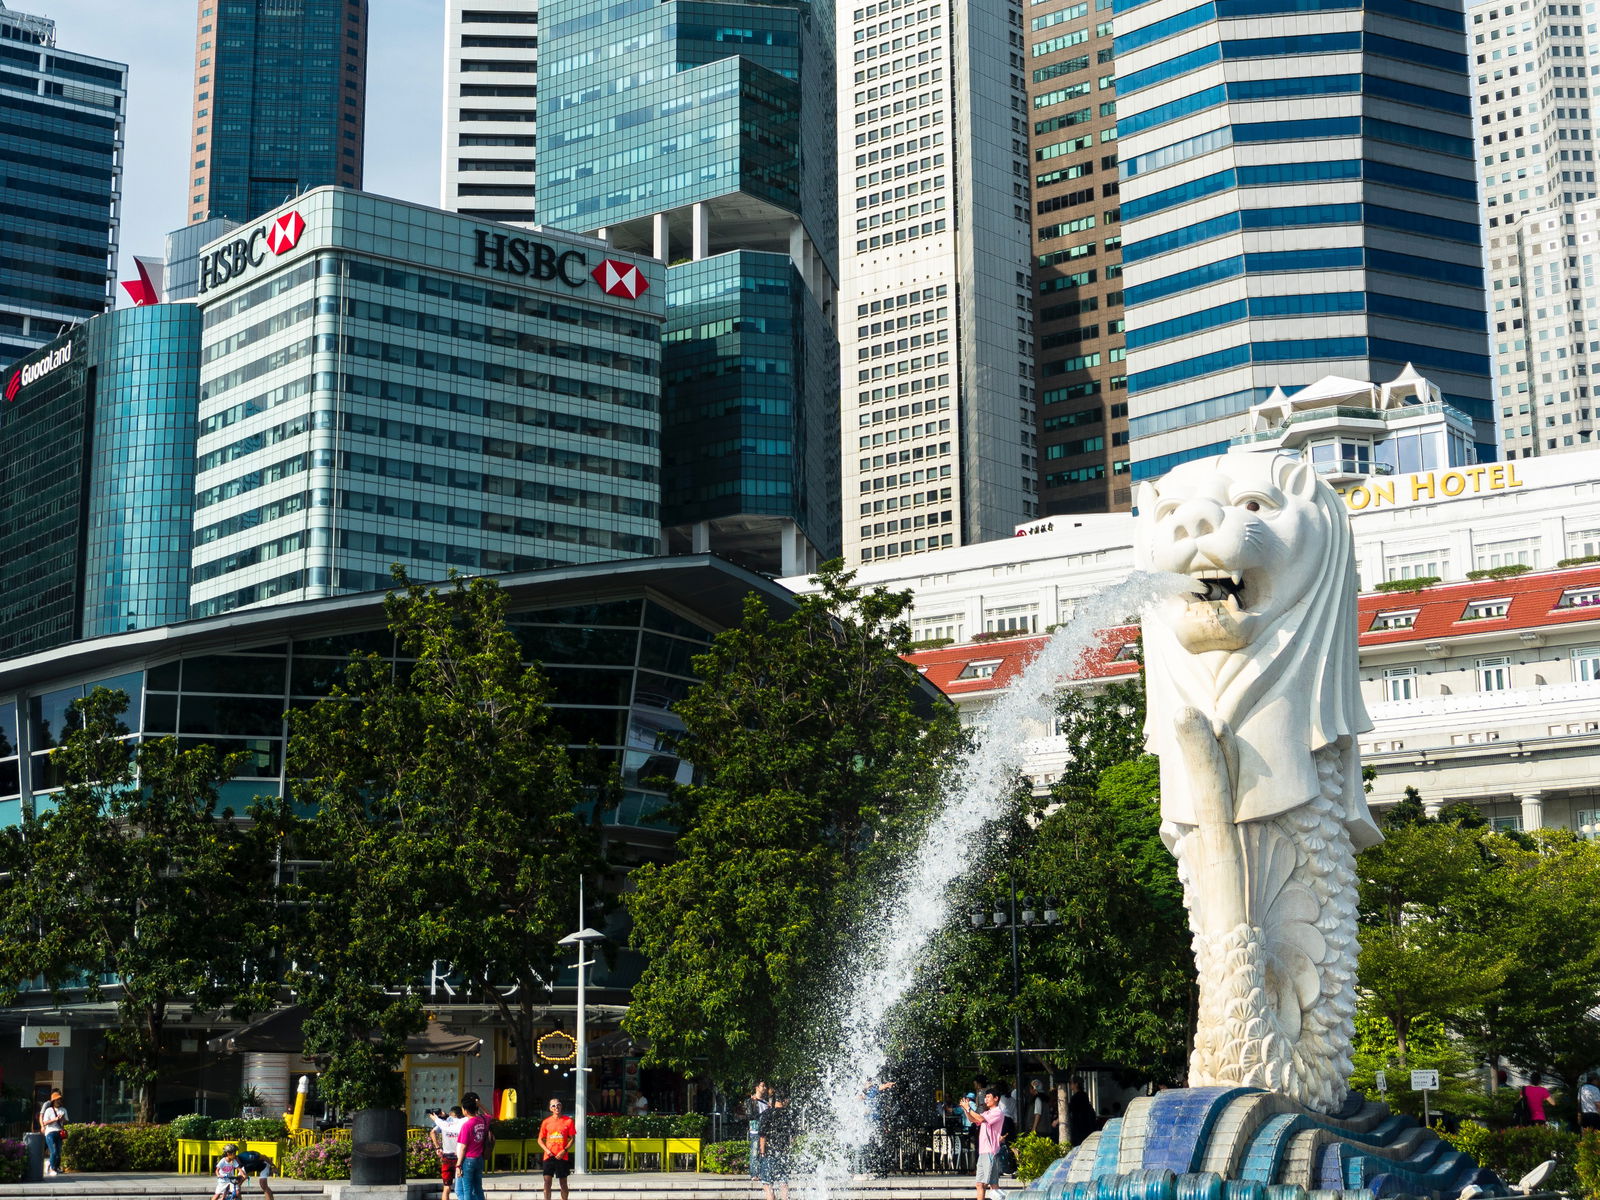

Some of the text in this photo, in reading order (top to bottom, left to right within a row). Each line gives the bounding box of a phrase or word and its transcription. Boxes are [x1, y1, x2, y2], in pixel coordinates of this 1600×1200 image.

[198, 225, 266, 294] HSBC
[474, 229, 587, 288] HSBC
[1410, 463, 1523, 501] HOTEL
